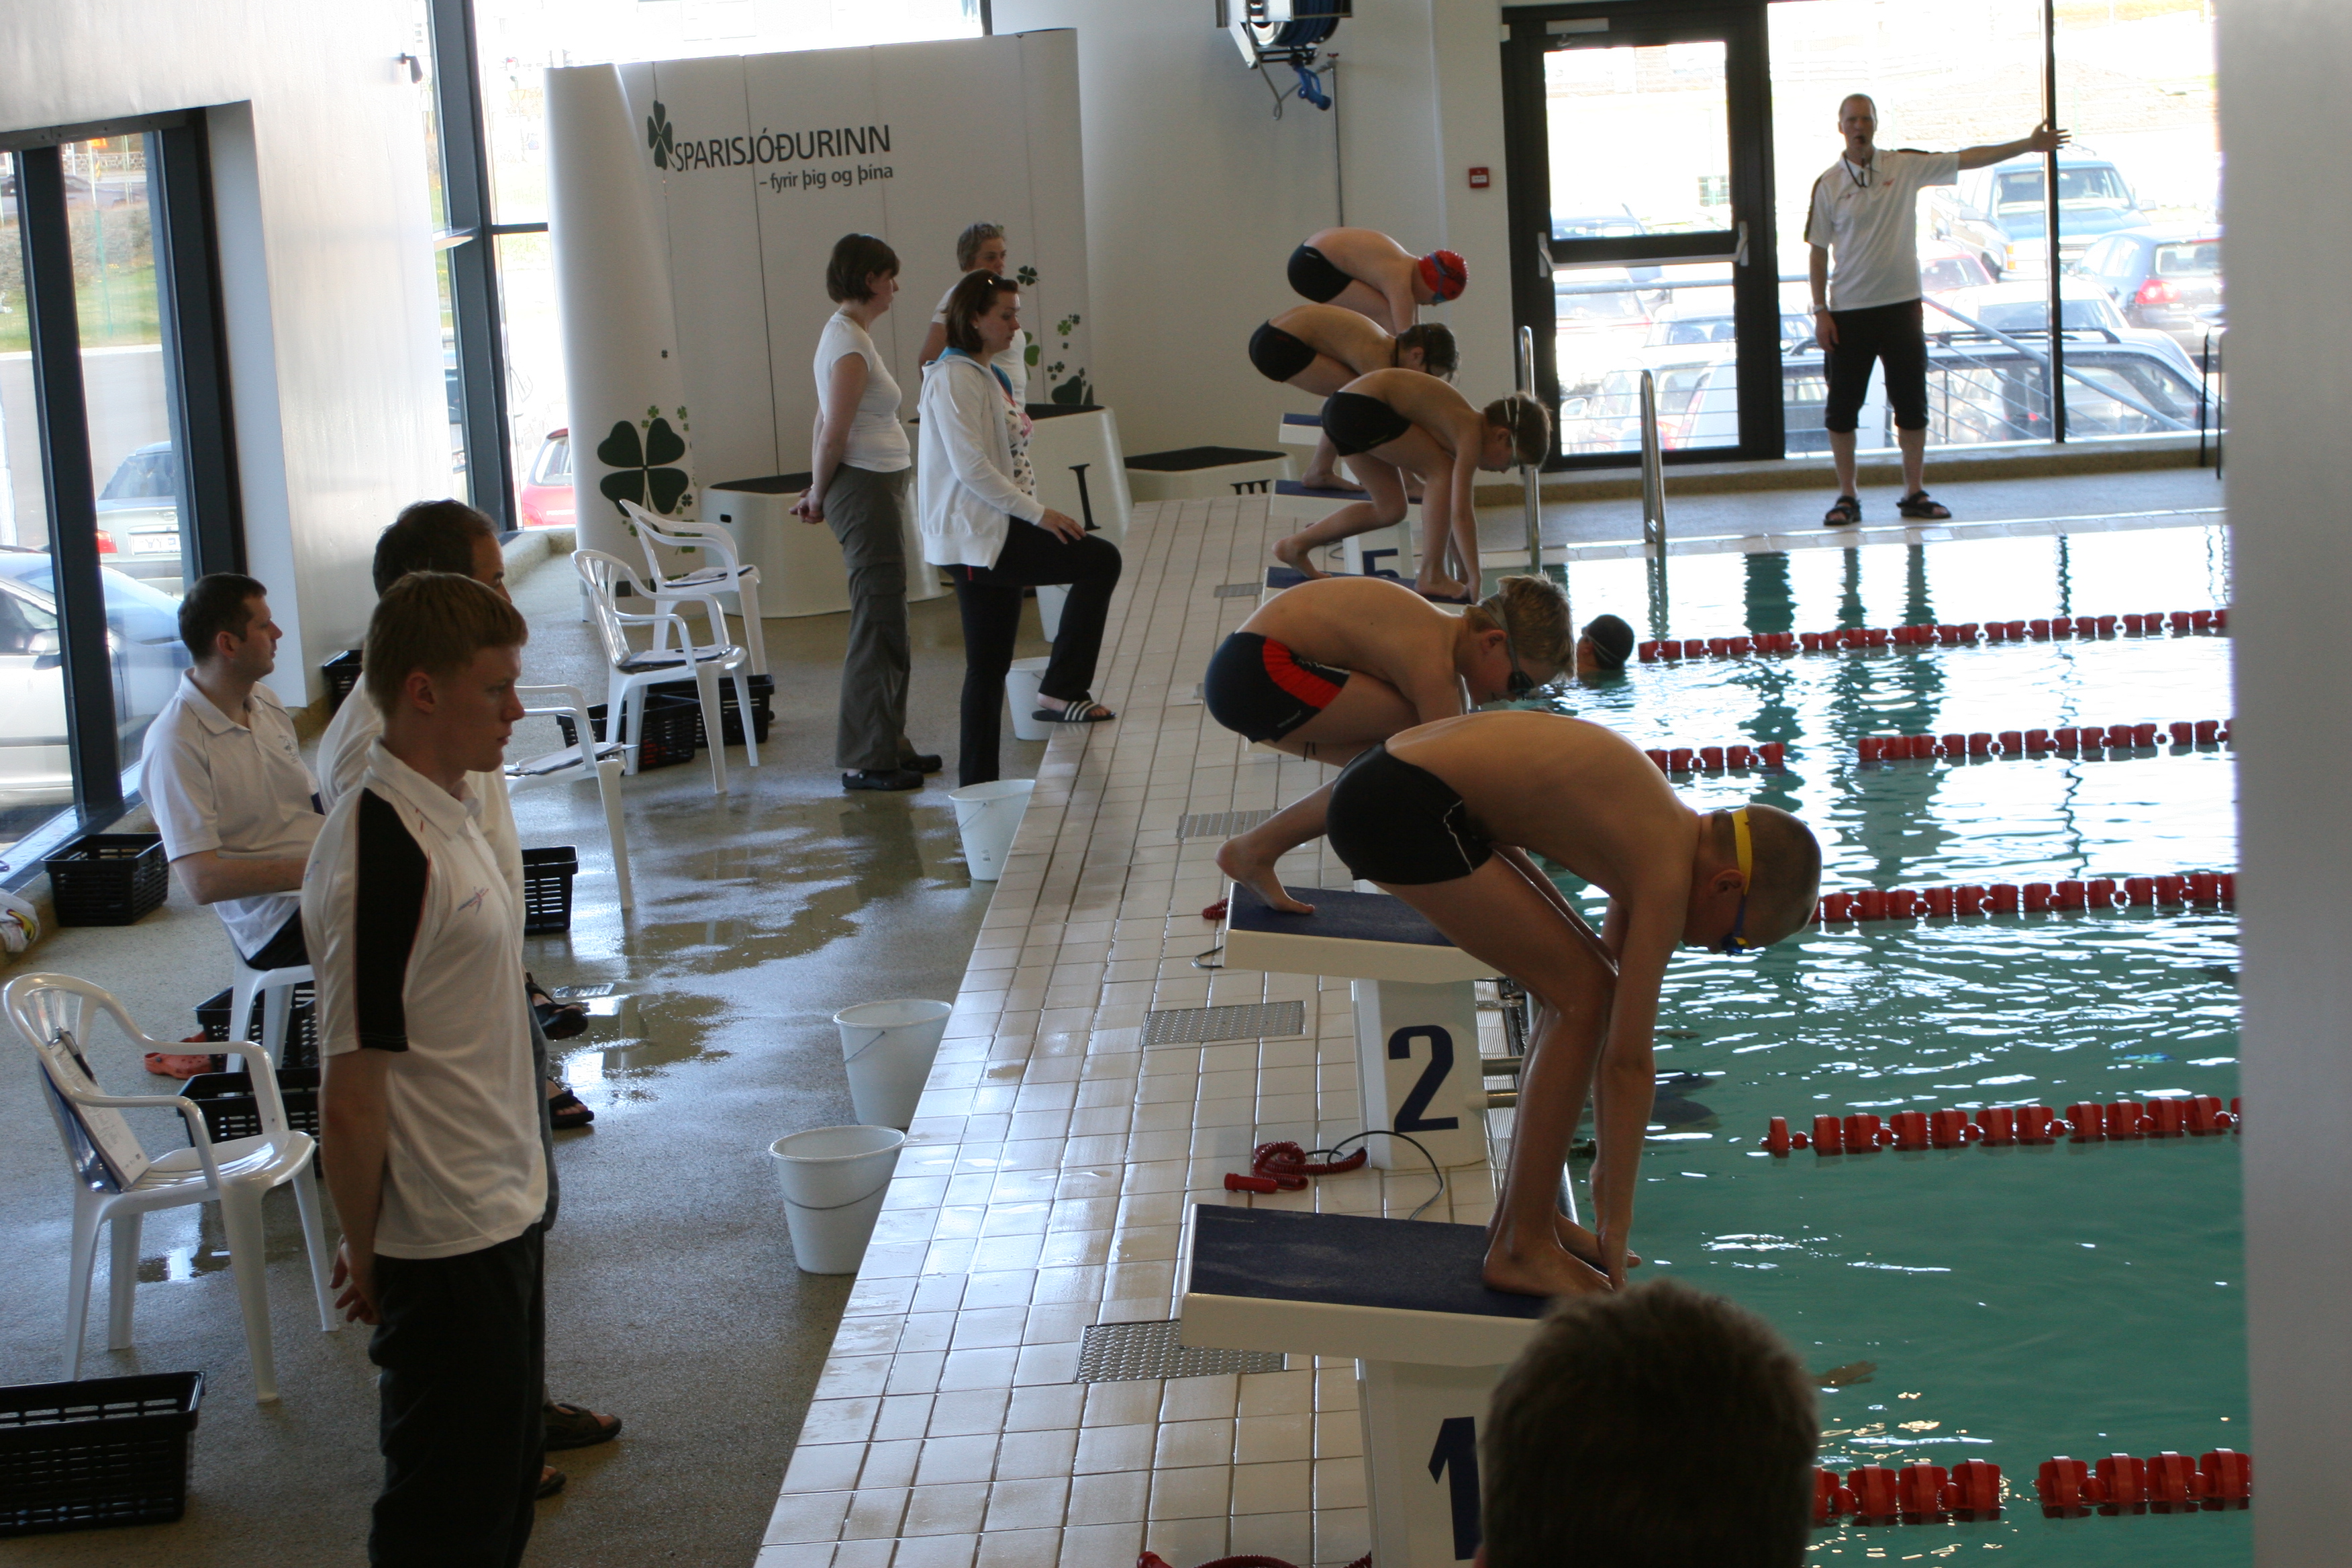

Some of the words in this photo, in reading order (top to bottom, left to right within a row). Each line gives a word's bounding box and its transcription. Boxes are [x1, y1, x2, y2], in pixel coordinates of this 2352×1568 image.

[675, 125, 891, 172] SPARISJÓÐURINN
[770, 172, 798, 193] fyrir
[803, 169, 826, 190] þig
[831, 169, 852, 187] og
[857, 164, 893, 185] þína
[1387, 1024, 1459, 1132] 2
[1427, 1416, 1484, 1561] 1
